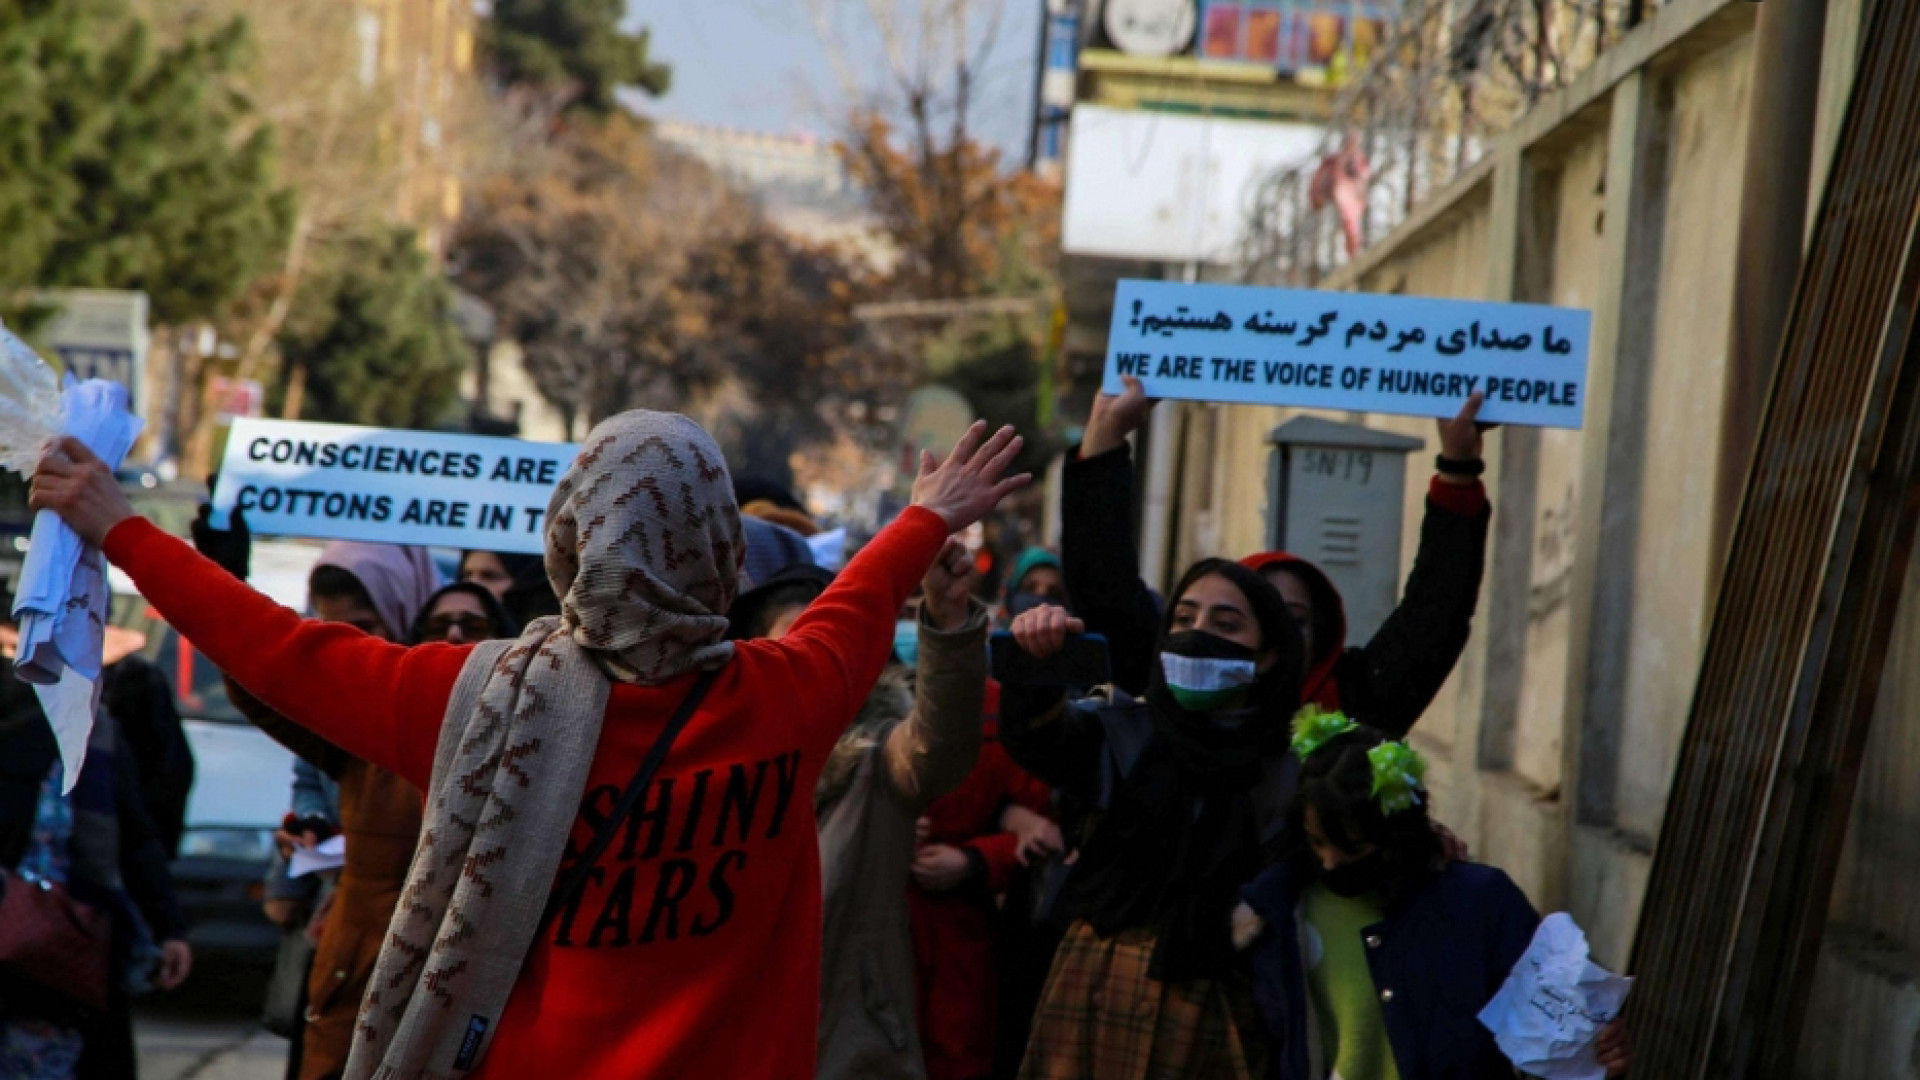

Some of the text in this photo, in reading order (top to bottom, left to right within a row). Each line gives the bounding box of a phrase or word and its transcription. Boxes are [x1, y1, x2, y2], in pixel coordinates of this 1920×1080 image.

[1130, 299, 1571, 355] ما صدای مردم گرسنه هستیم!
[1116, 352, 1577, 406] WE ARE THE VOICE OF HUNGRY PEOPLE
[248, 437, 557, 484] CONSCIENCES ARE
[237, 484, 392, 522] COTTONS
[401, 499, 469, 528] ARE
[477, 504, 512, 532] IN
[565, 750, 801, 861] SHINY
